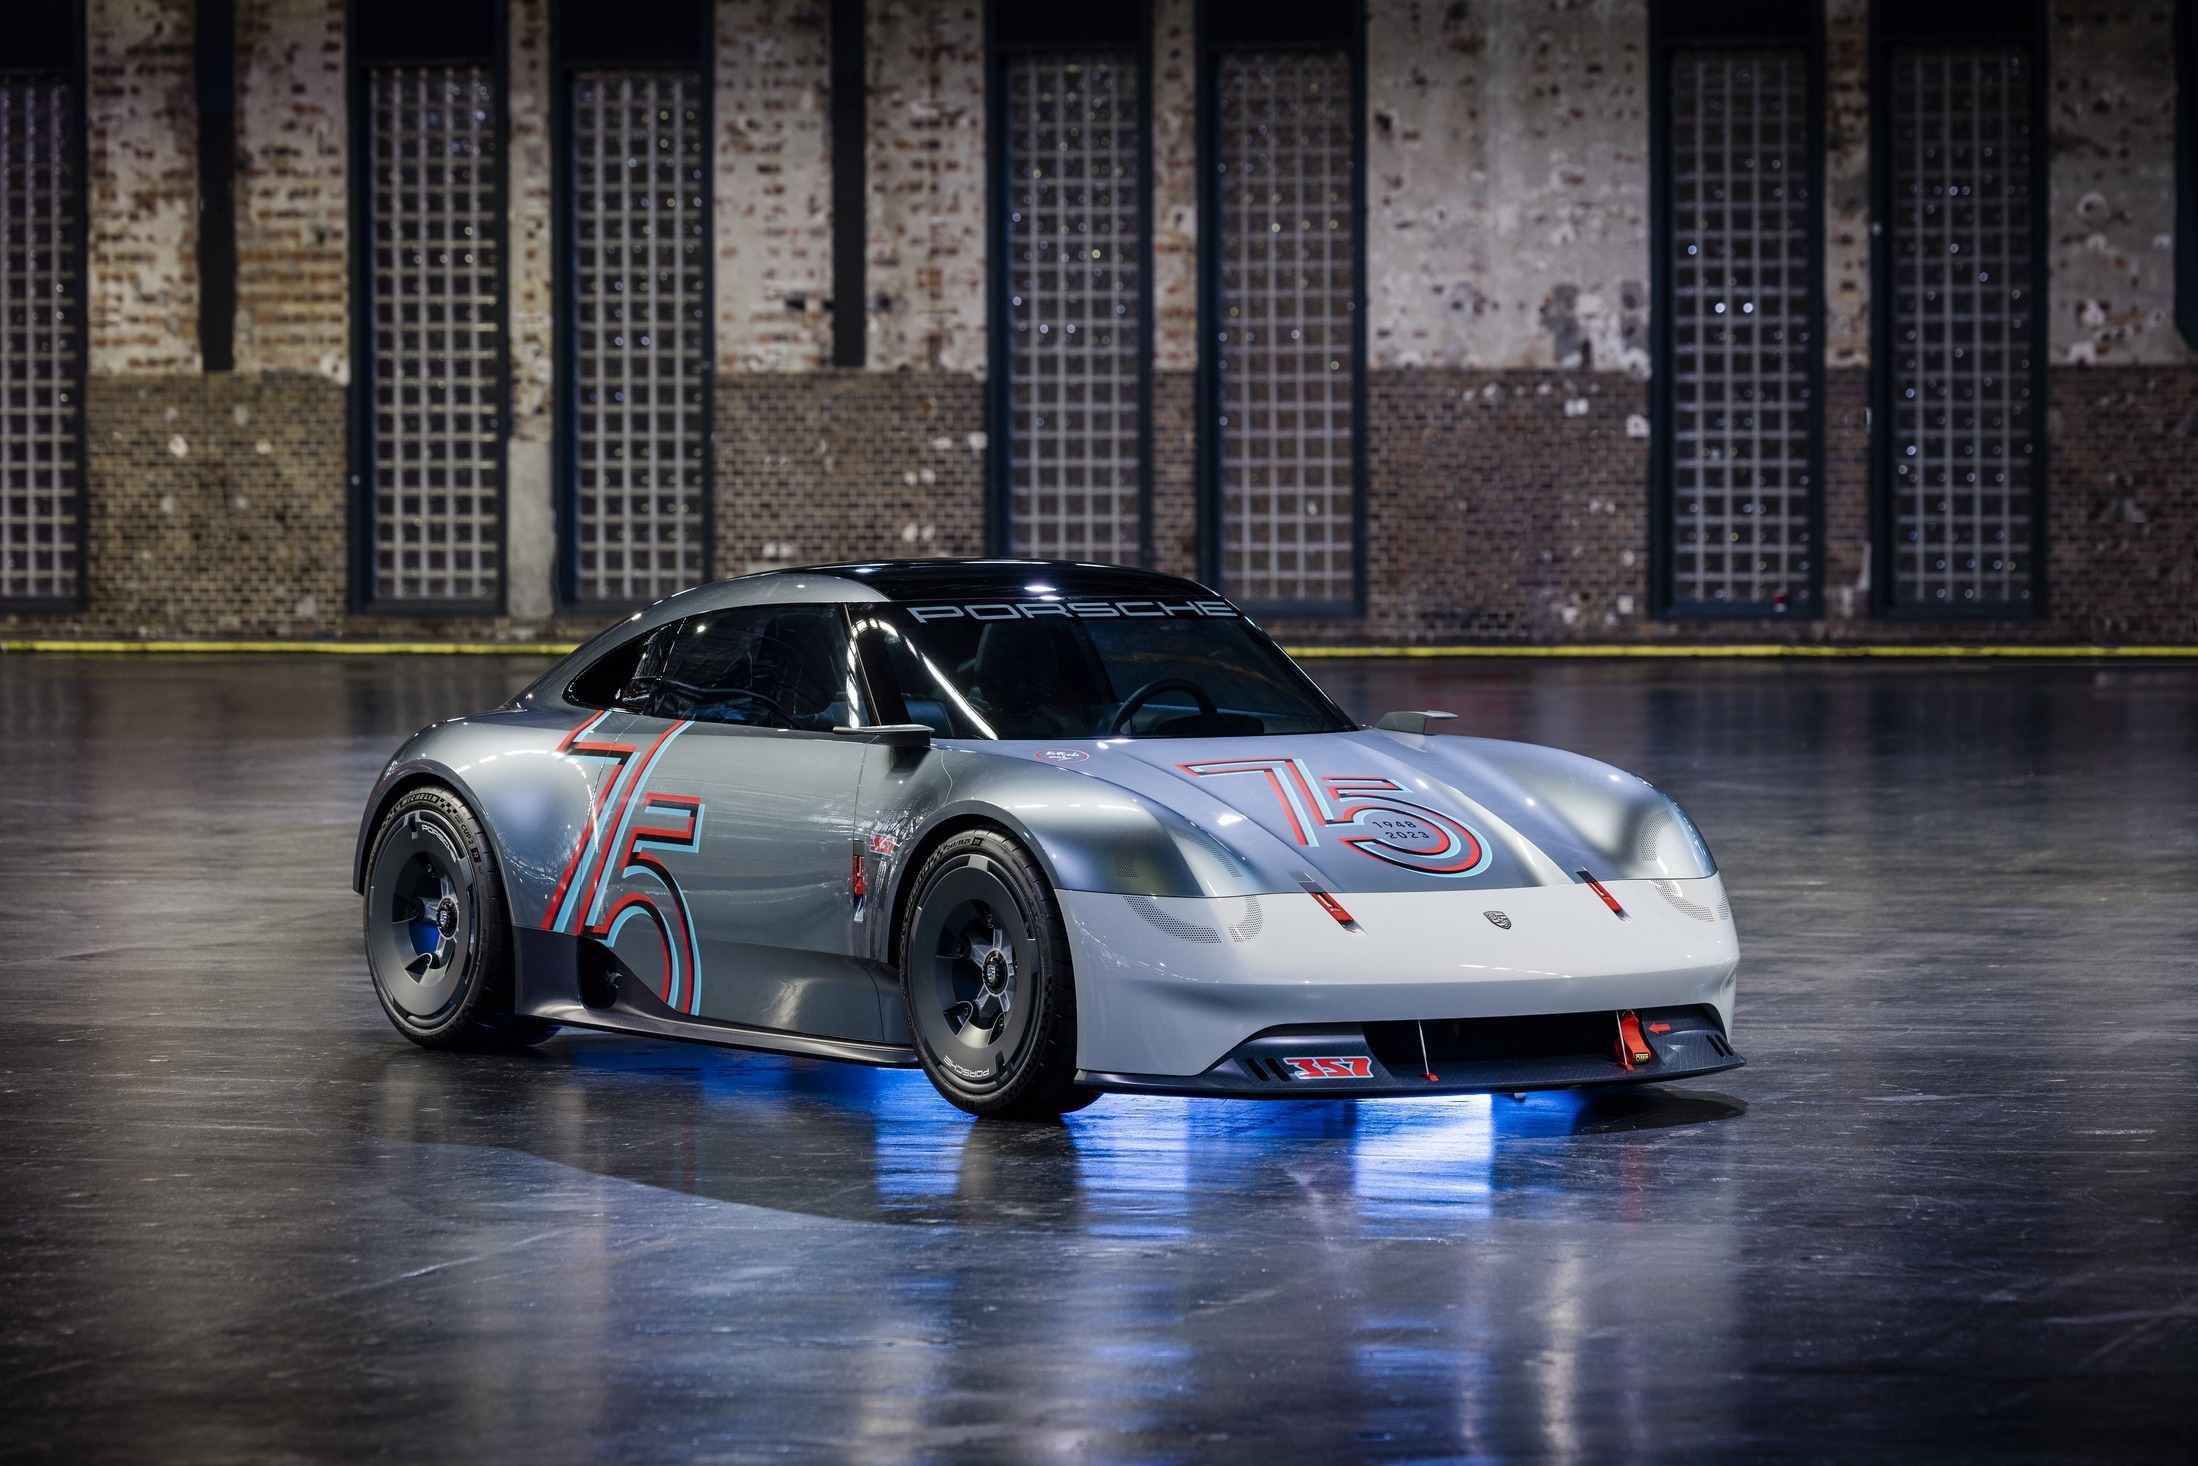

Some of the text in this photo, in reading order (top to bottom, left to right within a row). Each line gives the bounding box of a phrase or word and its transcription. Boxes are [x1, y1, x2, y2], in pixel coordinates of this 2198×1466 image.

[906, 600, 1239, 624] PORSCHE
[401, 792, 440, 807] MICHELIN
[1174, 758, 1493, 878] 75
[1372, 820, 1417, 829] 1948
[460, 824, 472, 839] CUP
[1385, 831, 1430, 839] 2023
[943, 1055, 990, 1078] PORSCHE
[1283, 1056, 1374, 1079] 357
